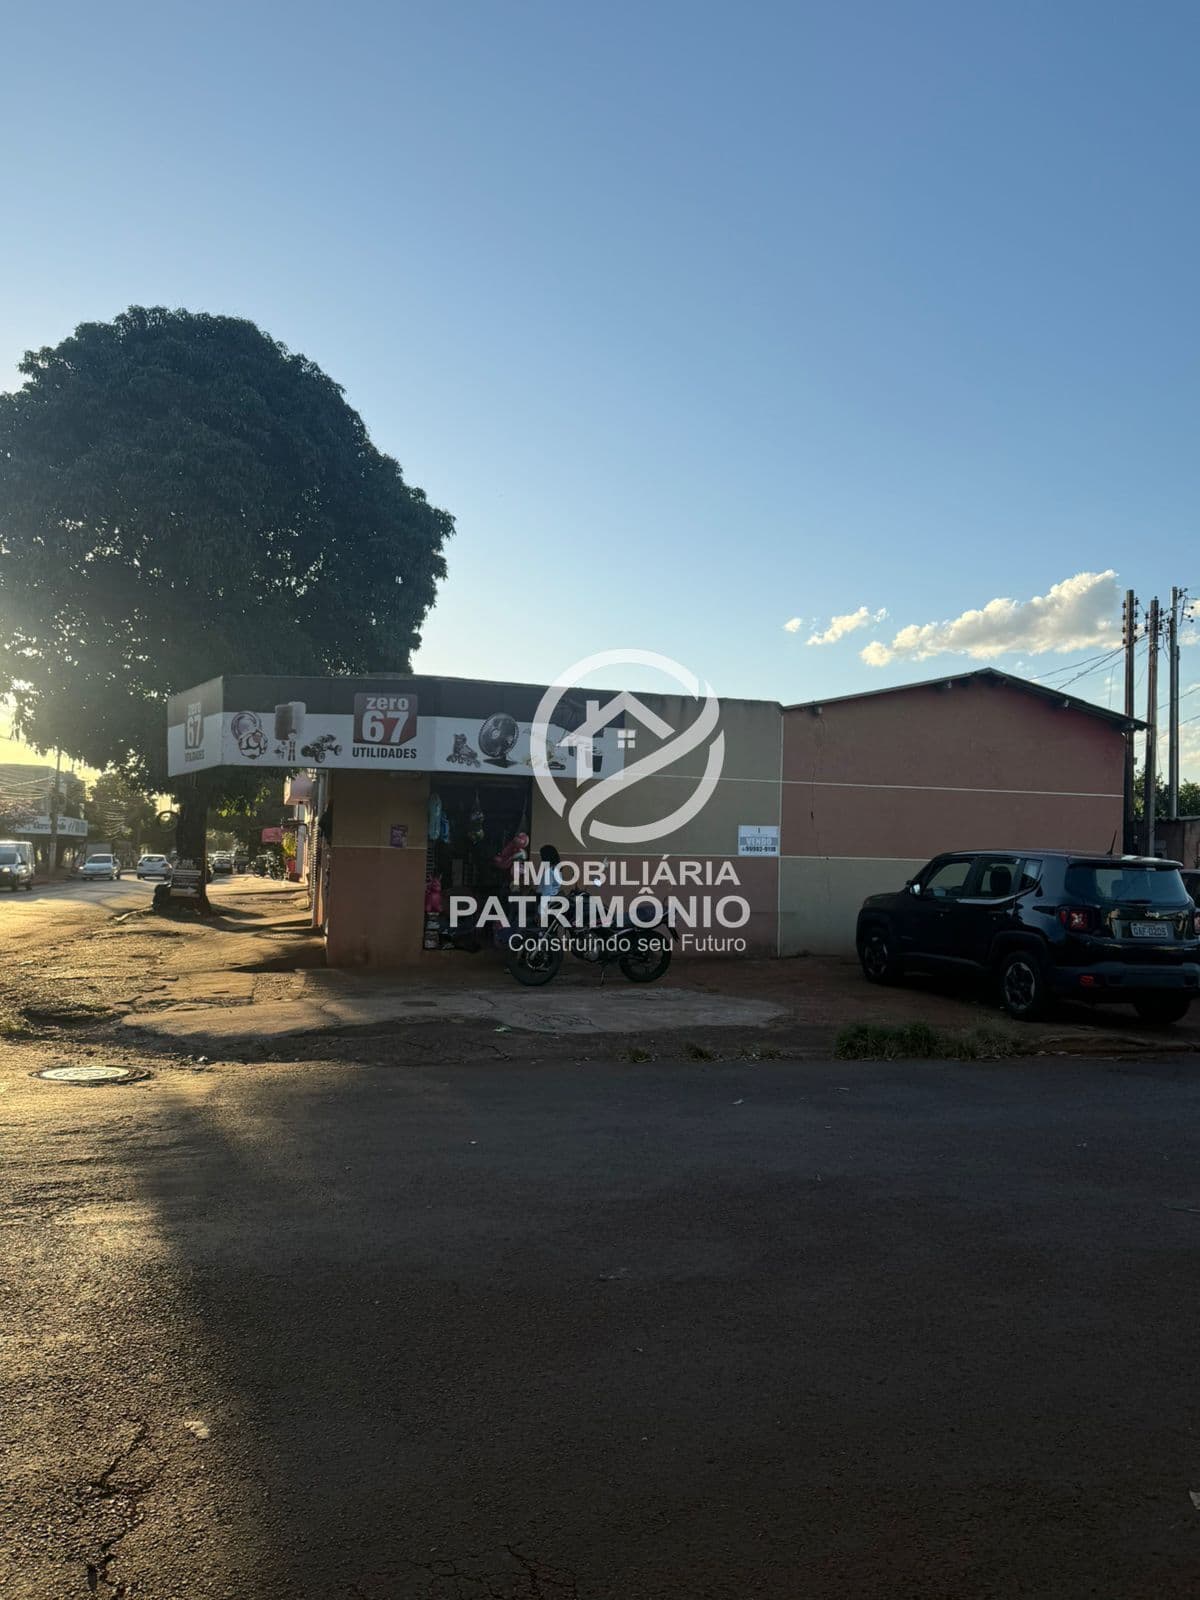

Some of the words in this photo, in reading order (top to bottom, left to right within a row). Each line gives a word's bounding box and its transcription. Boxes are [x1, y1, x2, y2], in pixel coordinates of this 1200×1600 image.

[366, 696, 409, 711] zero
[187, 714, 202, 747] 67
[361, 711, 409, 744] 67
[352, 747, 417, 760] UTILIDADES
